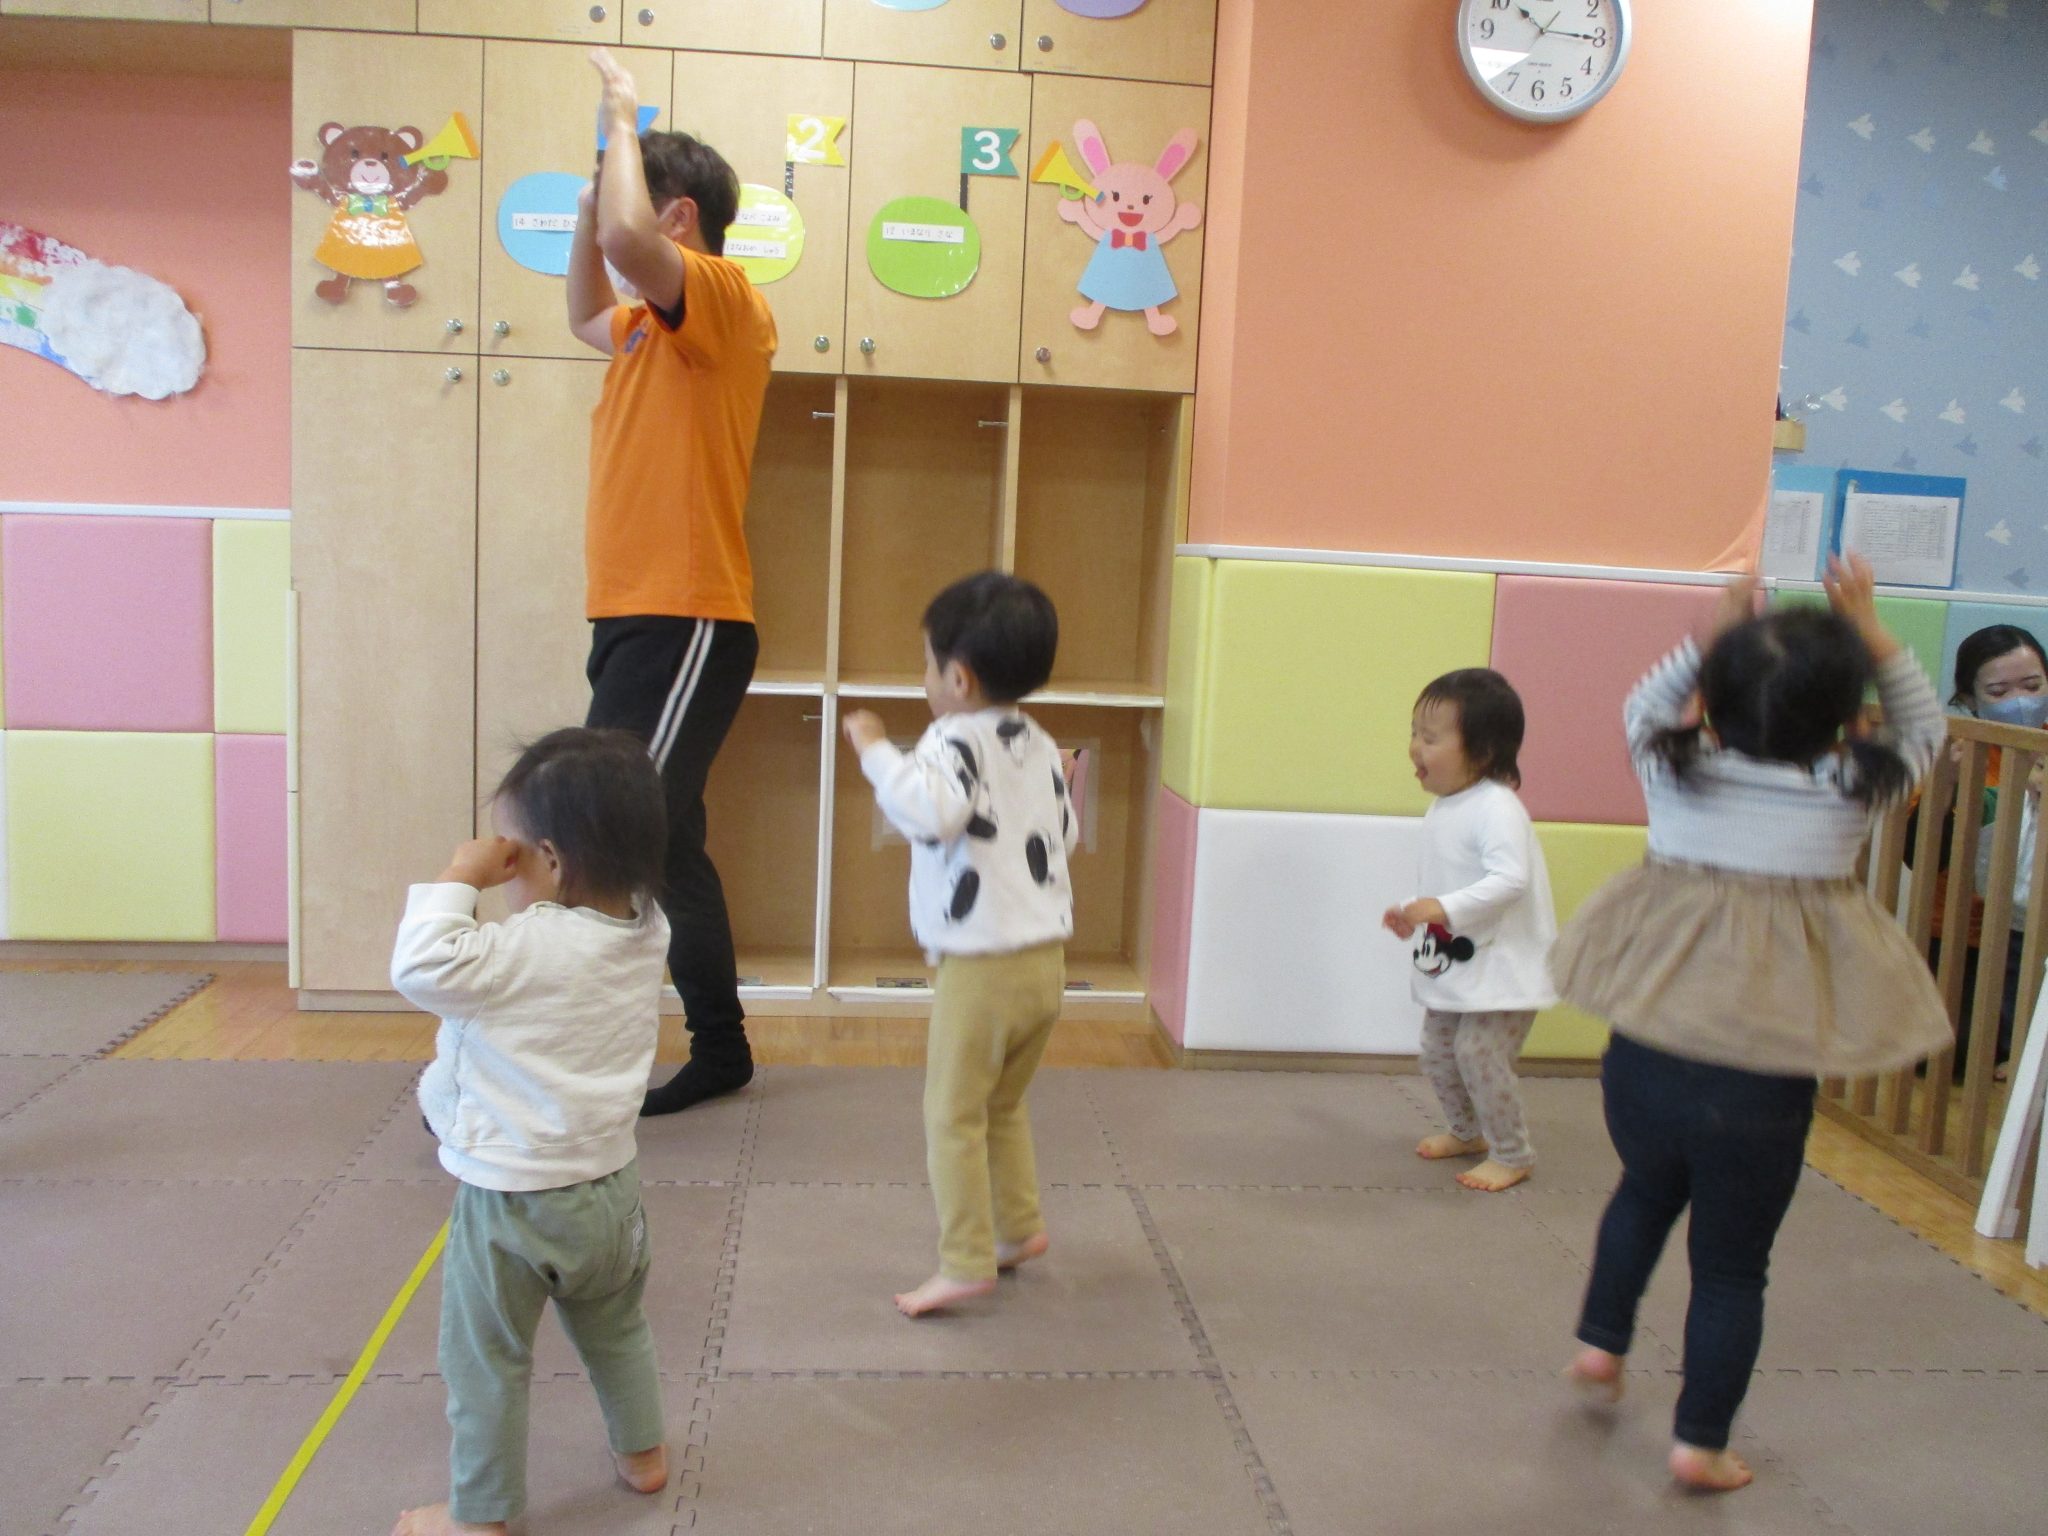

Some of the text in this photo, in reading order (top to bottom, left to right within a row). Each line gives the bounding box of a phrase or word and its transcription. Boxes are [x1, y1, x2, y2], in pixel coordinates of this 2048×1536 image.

[1586, 0, 1600, 18] 2
[1480, 18, 1495, 40] 9
[1592, 27, 1606, 48] 3
[1580, 56, 1592, 76] 4
[1507, 71, 1520, 92] 7
[1531, 79, 1545, 101] 6
[1559, 77, 1572, 97] 5
[796, 117, 826, 159] 2
[972, 130, 1001, 171] 3
